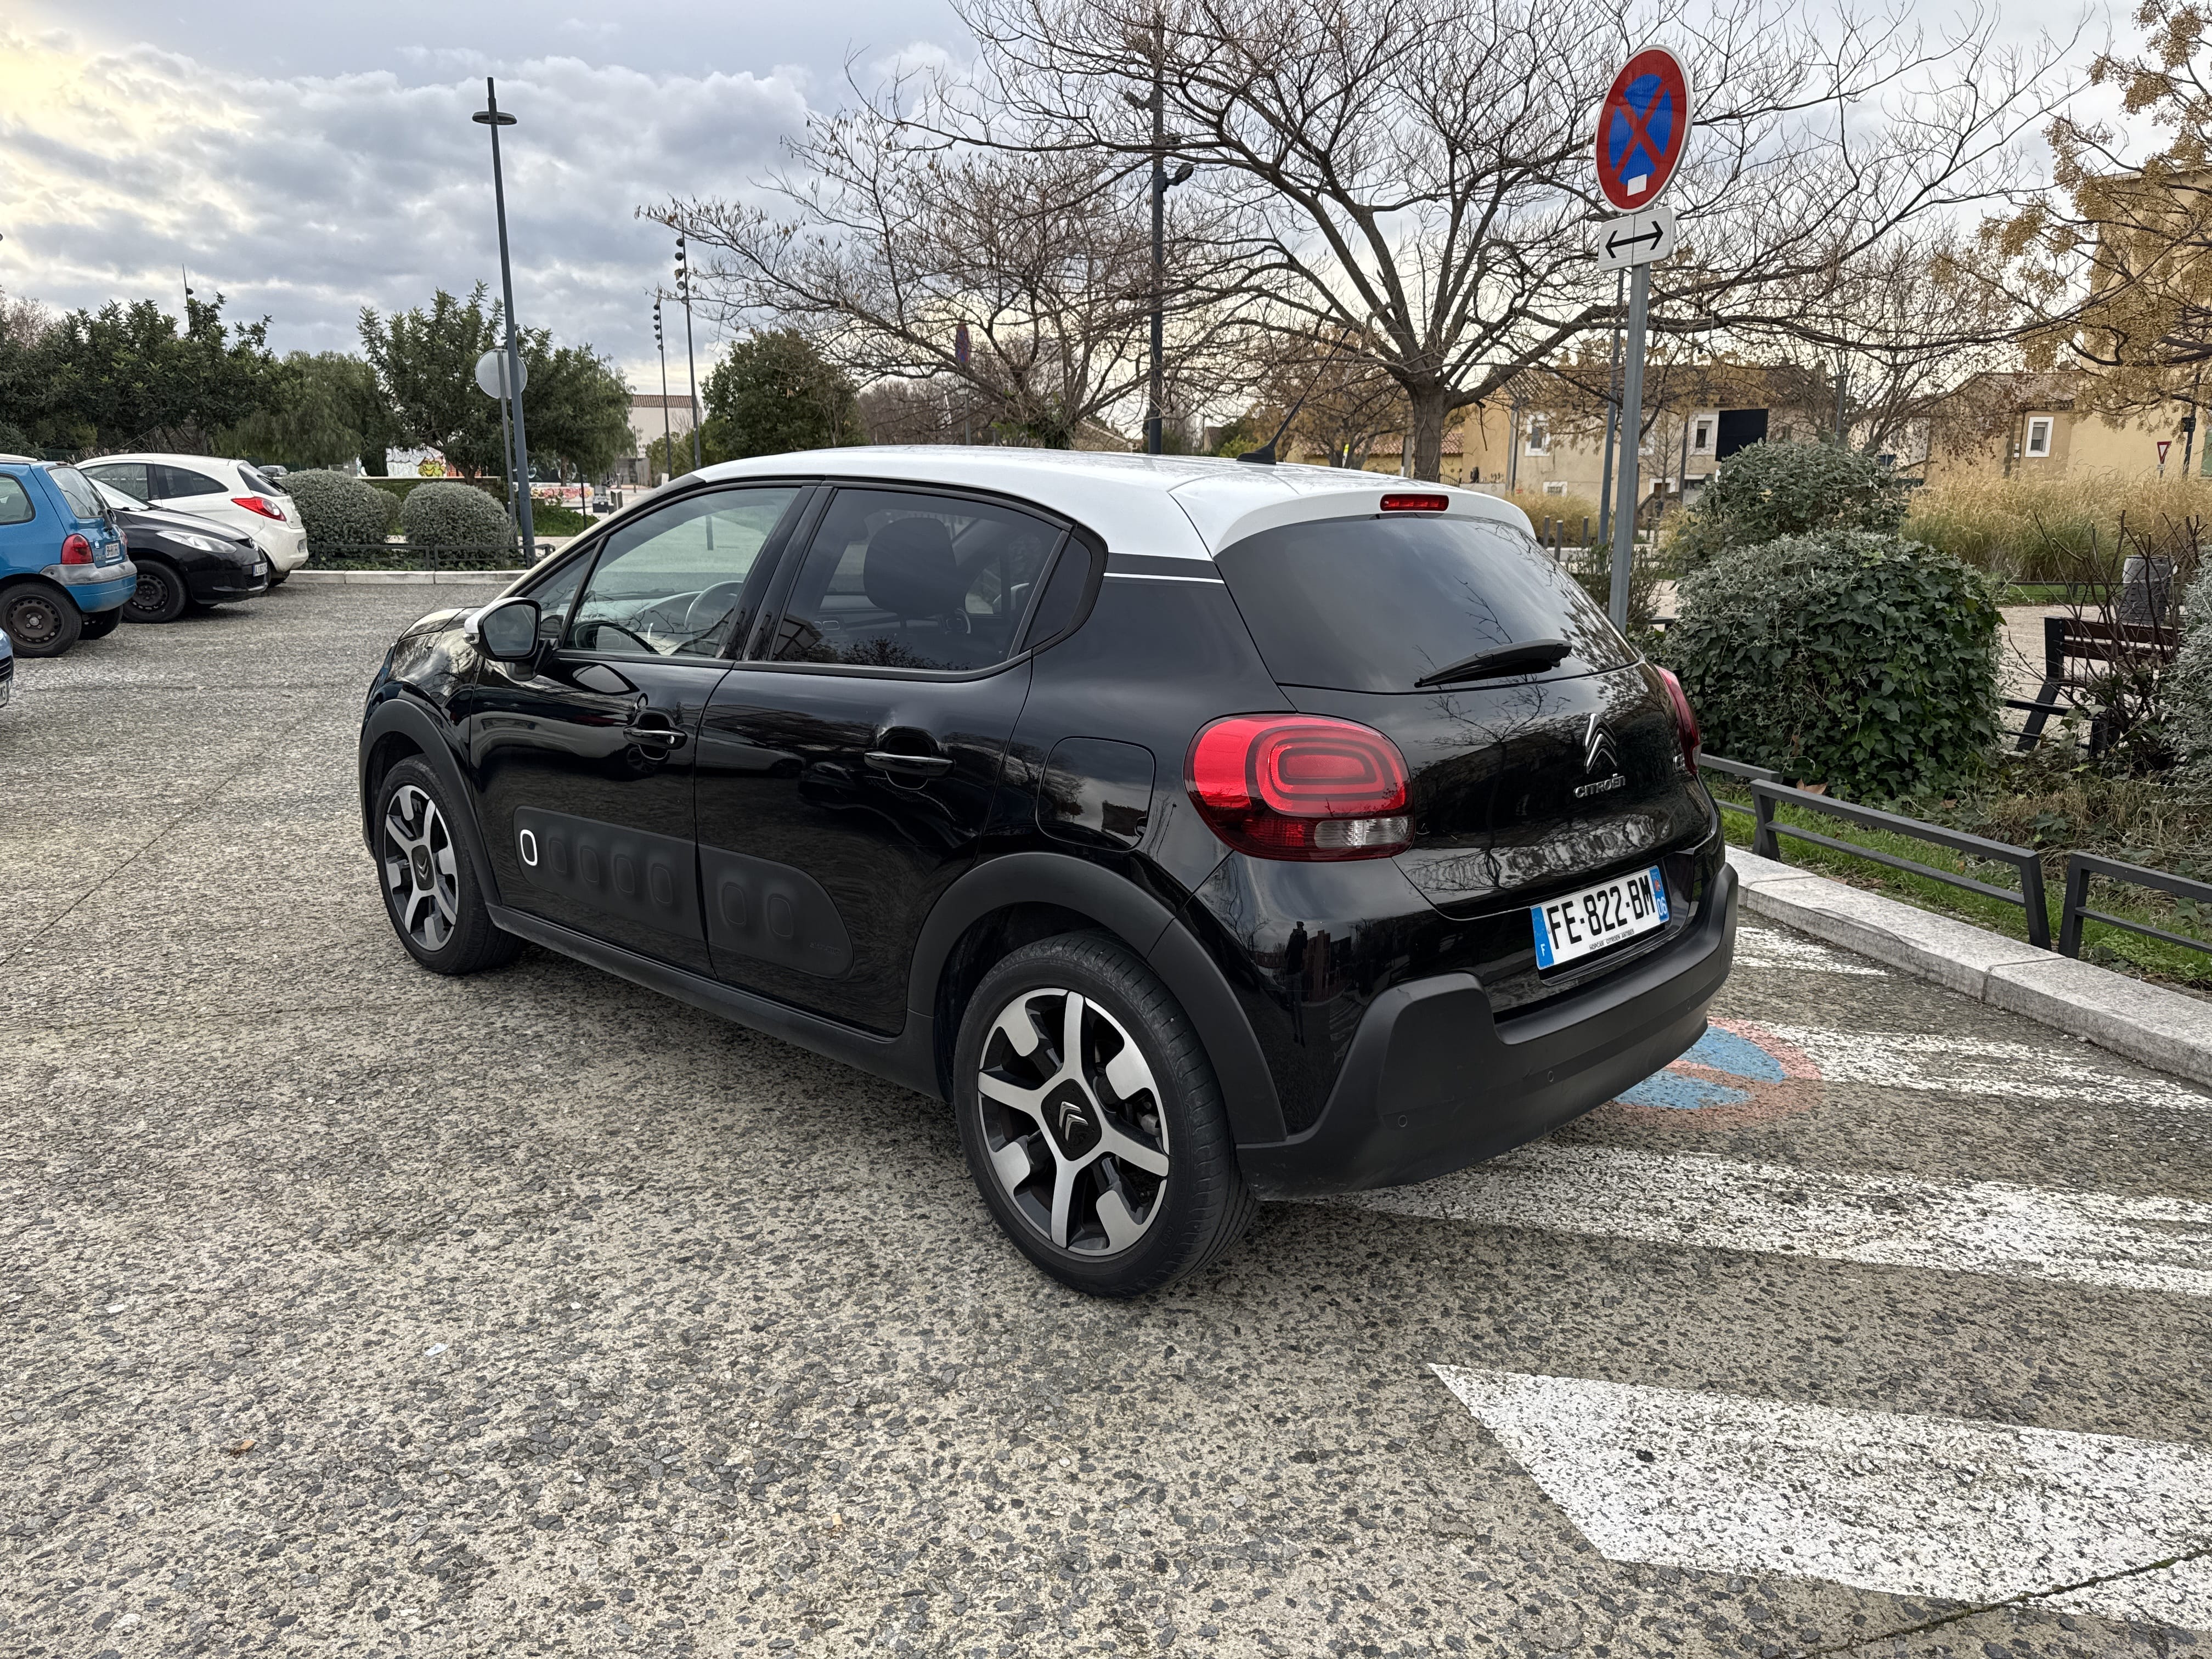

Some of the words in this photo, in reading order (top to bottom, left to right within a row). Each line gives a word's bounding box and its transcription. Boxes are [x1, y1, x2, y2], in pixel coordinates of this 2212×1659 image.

[1573, 773, 1626, 798] CITROËN
[1547, 875, 1655, 949] FE-822-BM
[1656, 896, 1667, 916] 06
[1540, 943, 1545, 956] F
